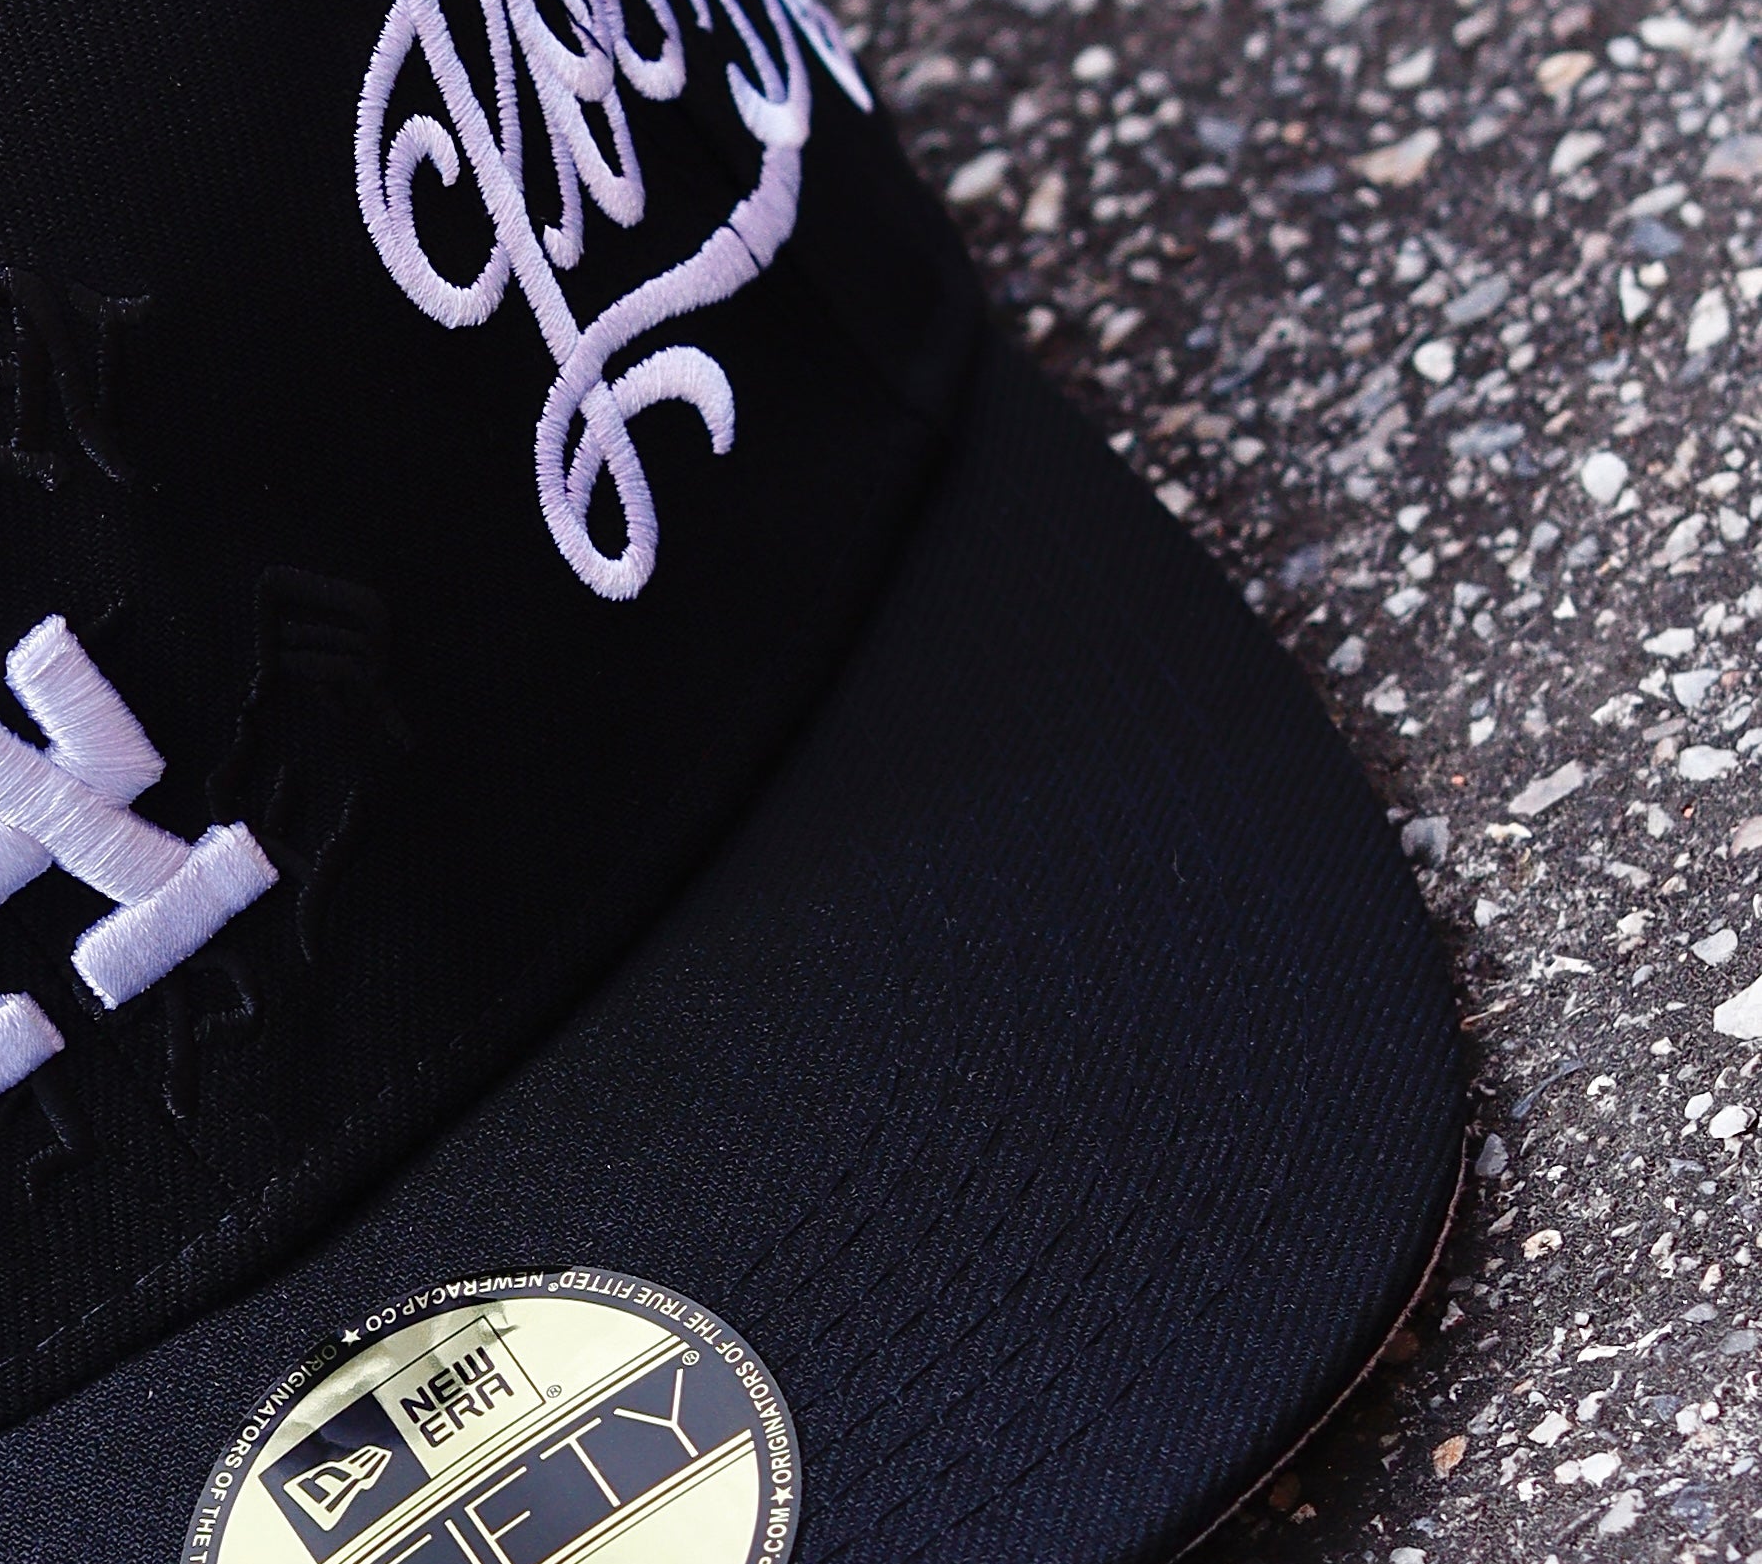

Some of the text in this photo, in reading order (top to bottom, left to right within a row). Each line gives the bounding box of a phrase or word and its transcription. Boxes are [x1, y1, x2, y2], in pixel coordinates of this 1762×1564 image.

[634, 1286, 688, 1321] TRUE
[684, 1311, 722, 1345] THE
[715, 1341, 744, 1363] OF
[225, 1343, 337, 1469] ORIGINATORS
[400, 1346, 496, 1425] NEW
[420, 1373, 514, 1448] ERA
[734, 1361, 792, 1483] ORIGINATORS
[210, 1473, 233, 1501] OF
[192, 1505, 222, 1547] THE
